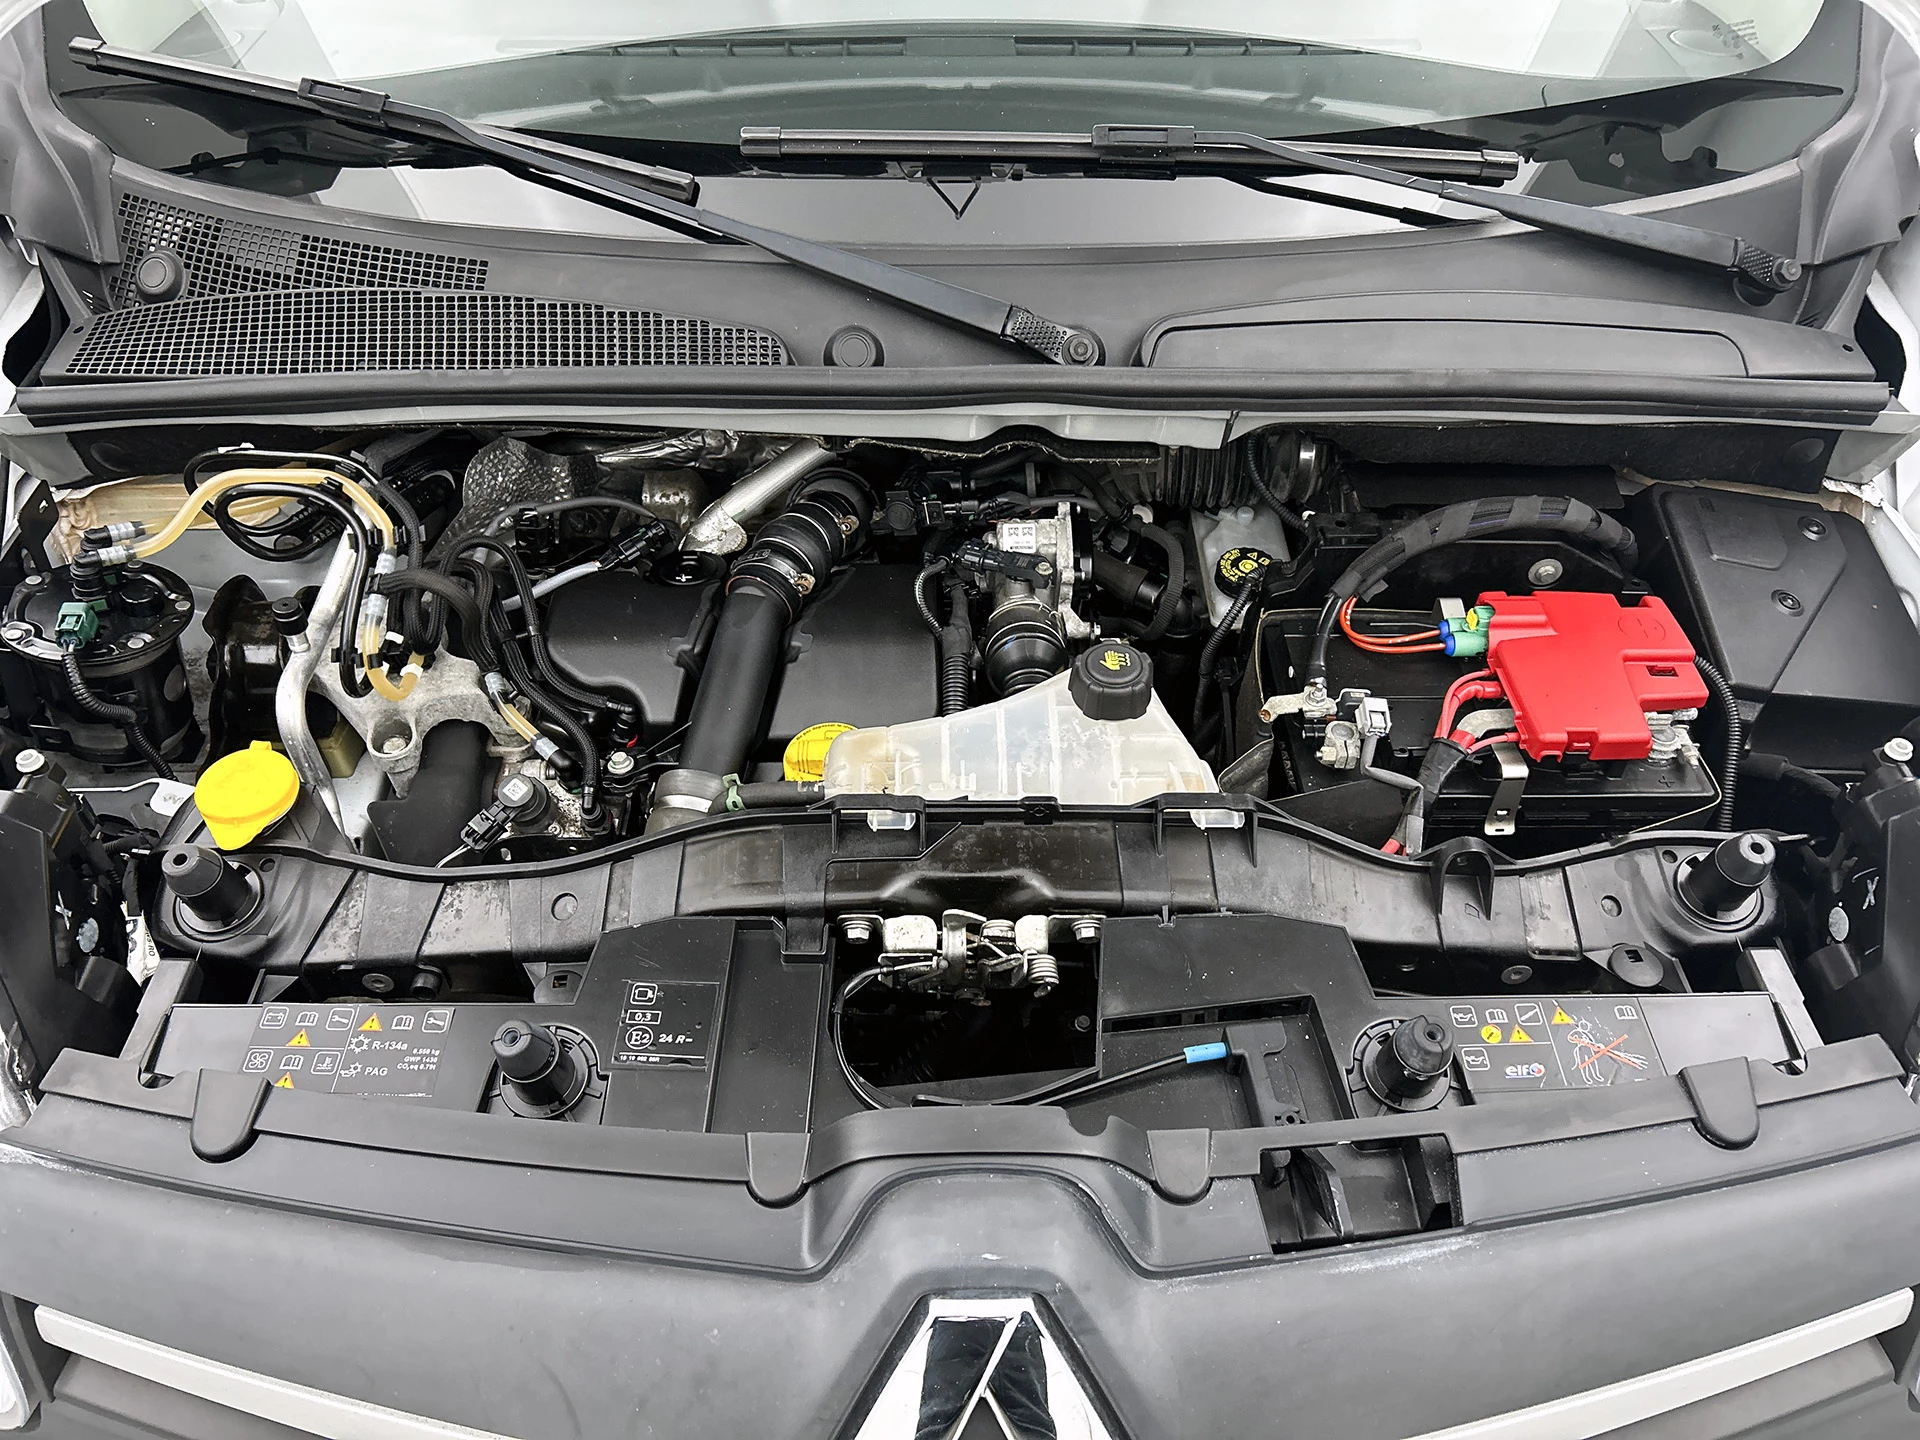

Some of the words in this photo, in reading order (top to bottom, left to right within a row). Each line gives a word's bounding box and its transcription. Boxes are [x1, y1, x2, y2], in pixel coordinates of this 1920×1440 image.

[635, 1013, 651, 1022] 0,3
[630, 1031, 650, 1045] E2
[659, 1034, 673, 1043] 24
[372, 1041, 408, 1050] R-134a
[365, 1067, 388, 1076] PAG
[1505, 1065, 1529, 1075] elf
